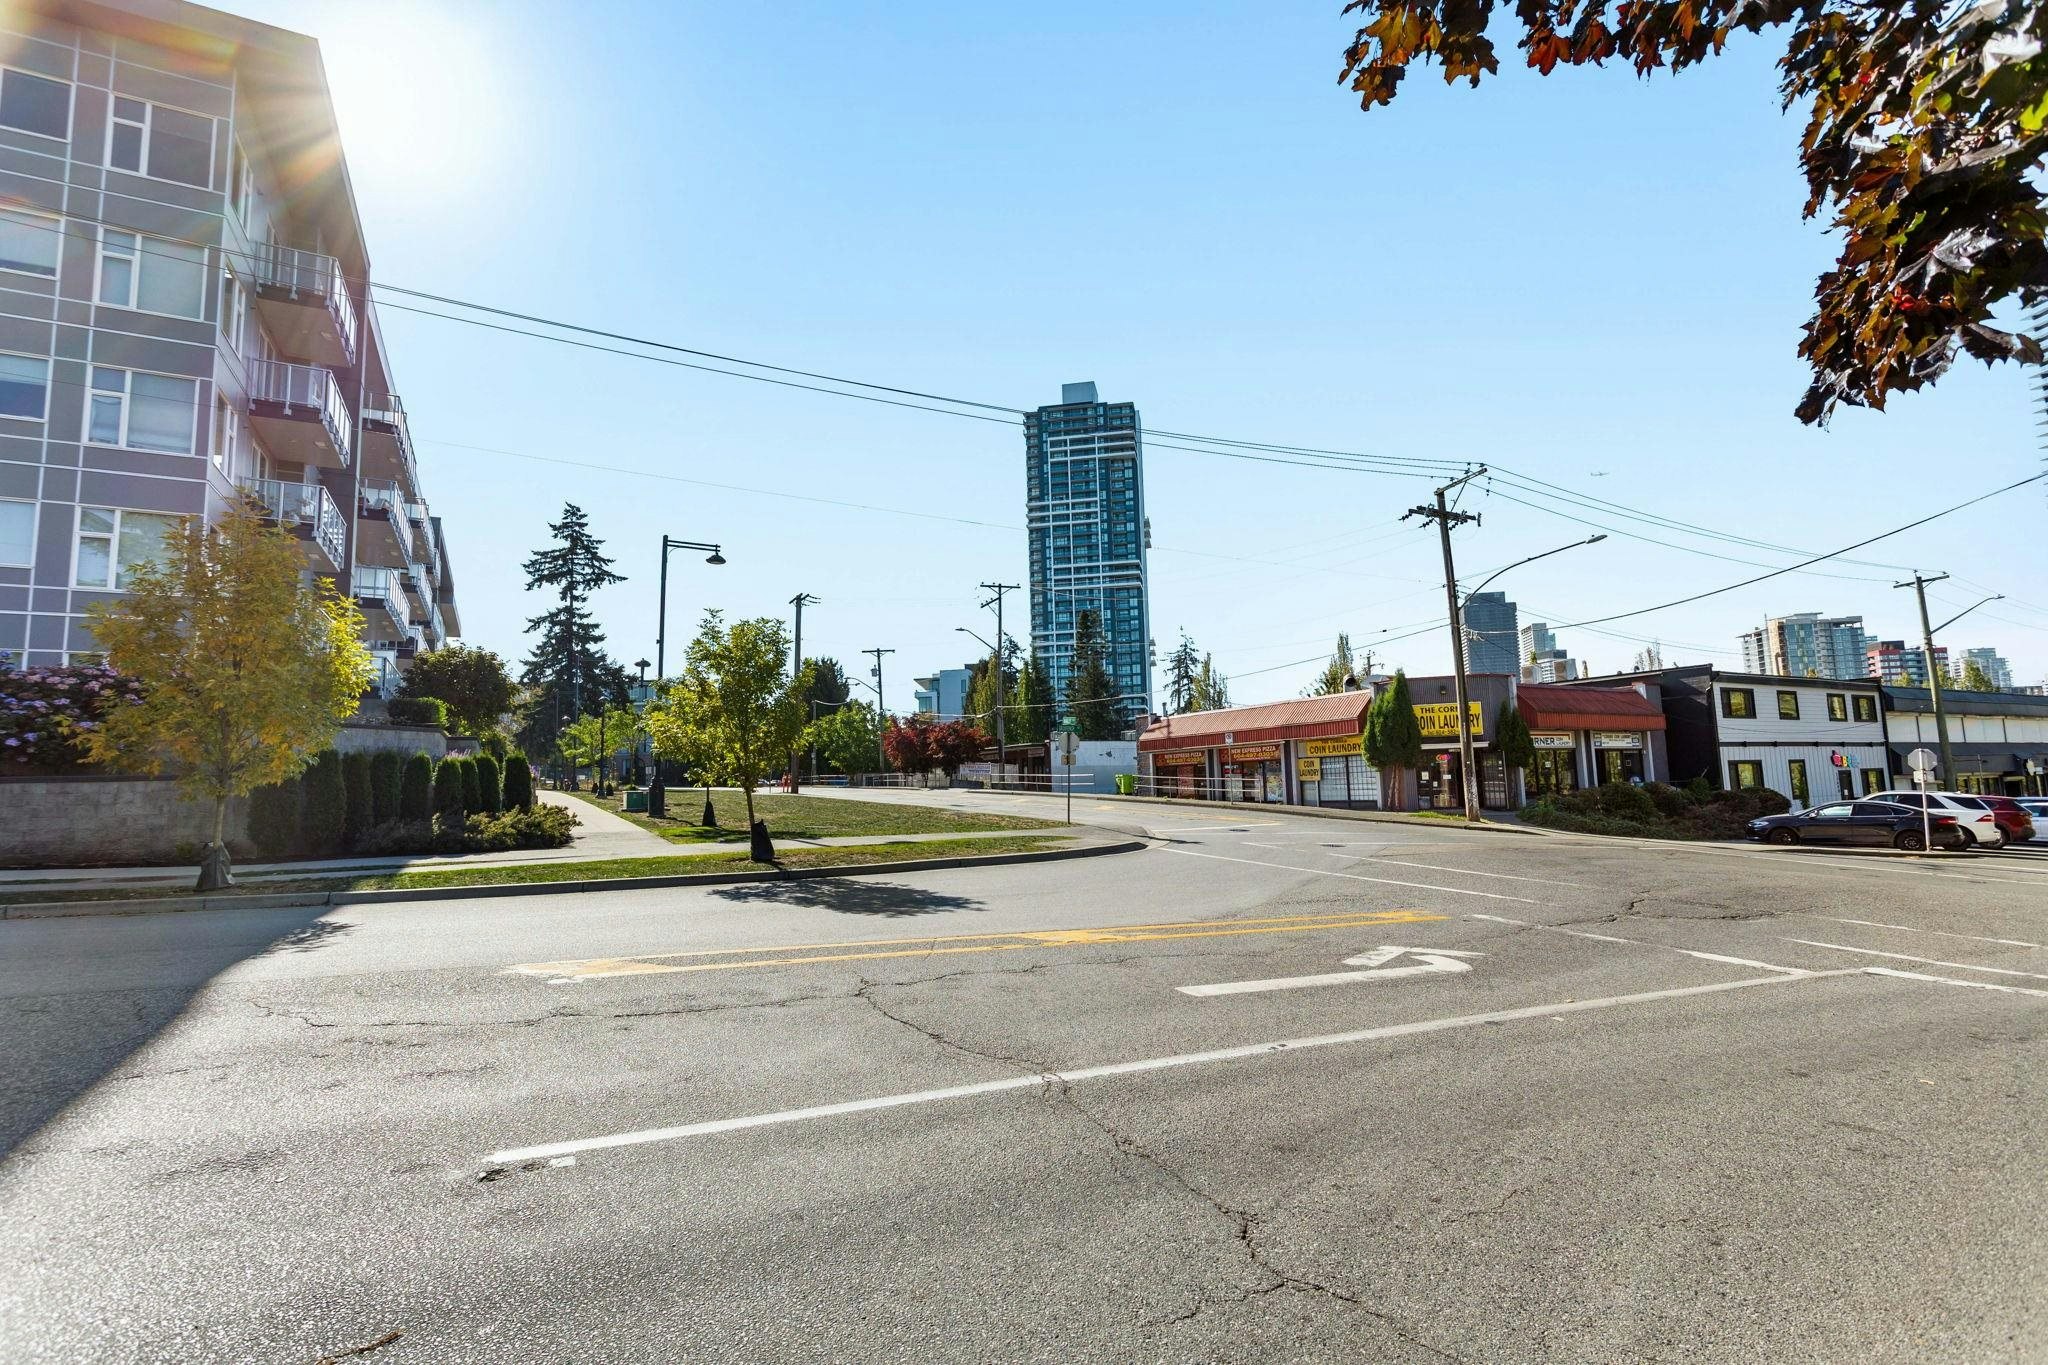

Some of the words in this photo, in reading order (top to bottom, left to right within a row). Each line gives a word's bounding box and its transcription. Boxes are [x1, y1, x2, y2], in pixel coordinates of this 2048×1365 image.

[1438, 705, 1472, 713] CORR
[1438, 713, 1480, 729] LAUNRY
[1309, 745, 1326, 754] COIN
[1328, 743, 1361, 754] LAUNDRY
[1300, 769, 1319, 777] LAUNDRY
